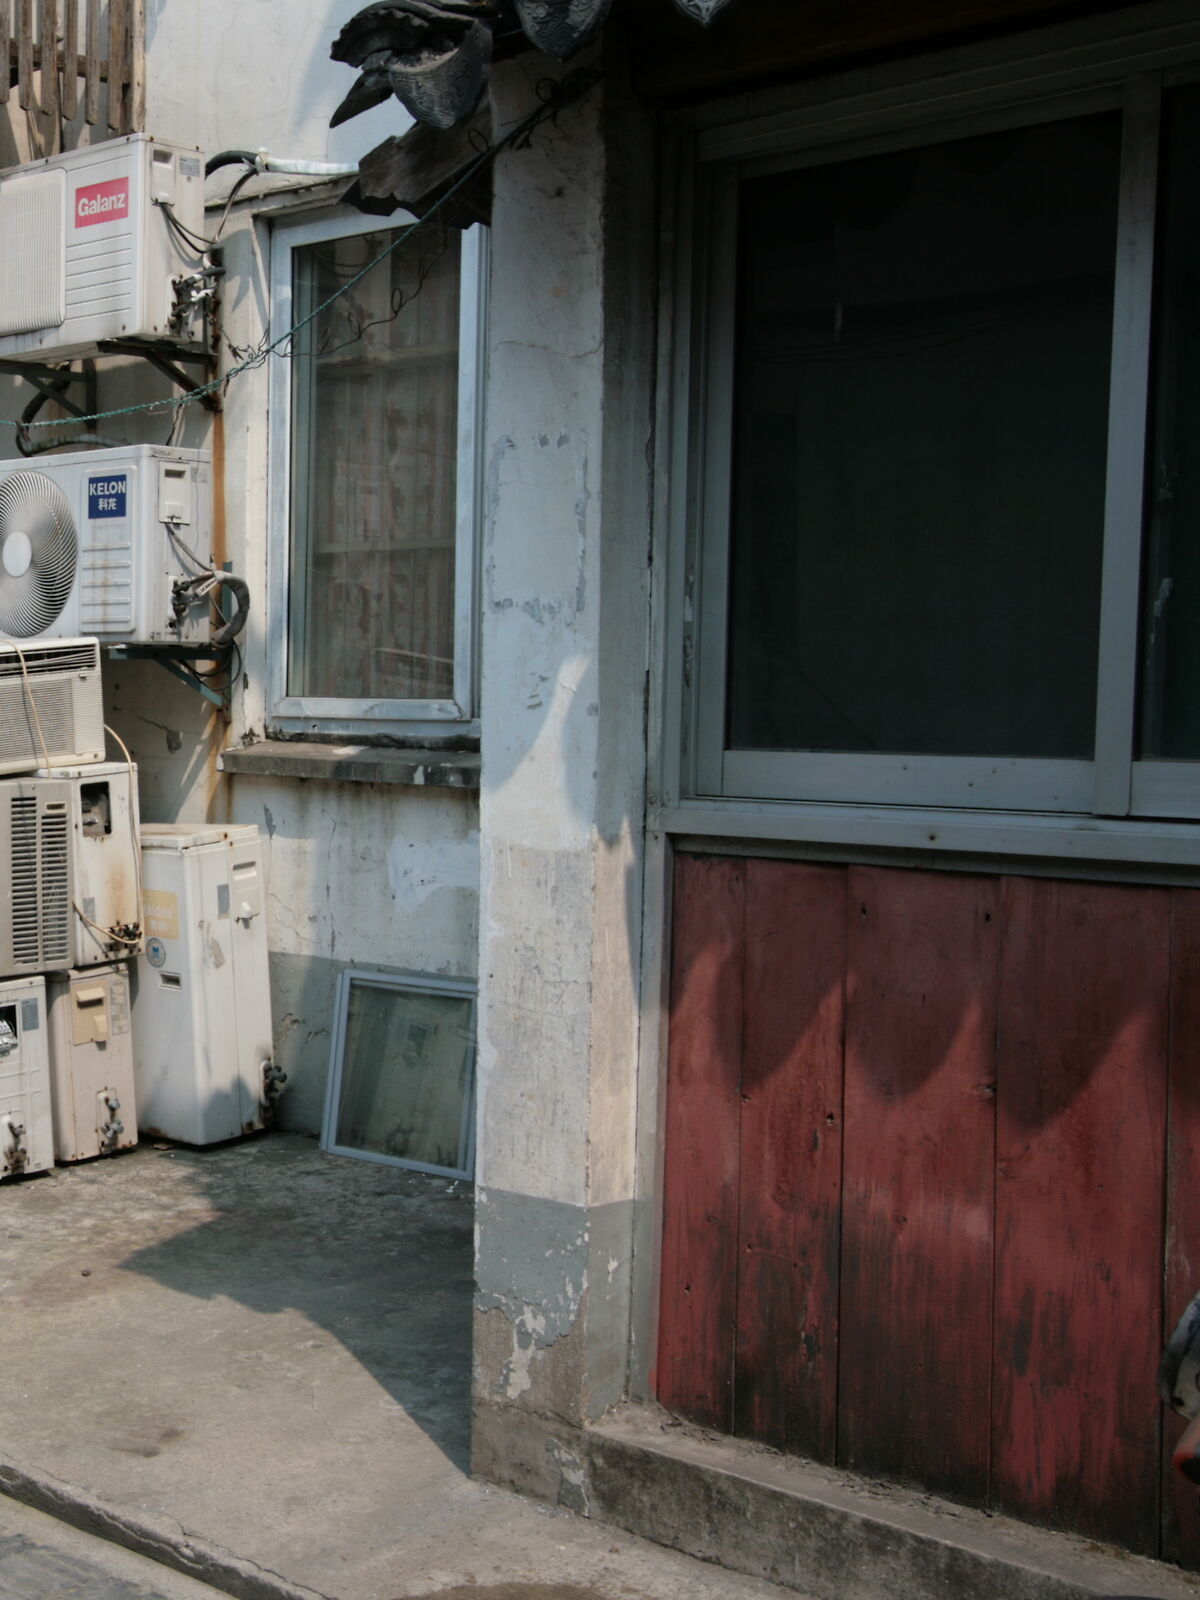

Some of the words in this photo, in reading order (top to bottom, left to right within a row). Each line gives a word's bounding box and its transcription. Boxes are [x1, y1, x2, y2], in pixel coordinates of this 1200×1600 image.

[78, 193, 126, 216] Galanz
[89, 481, 126, 496] KELON
[98, 498, 117, 511] 科龙
